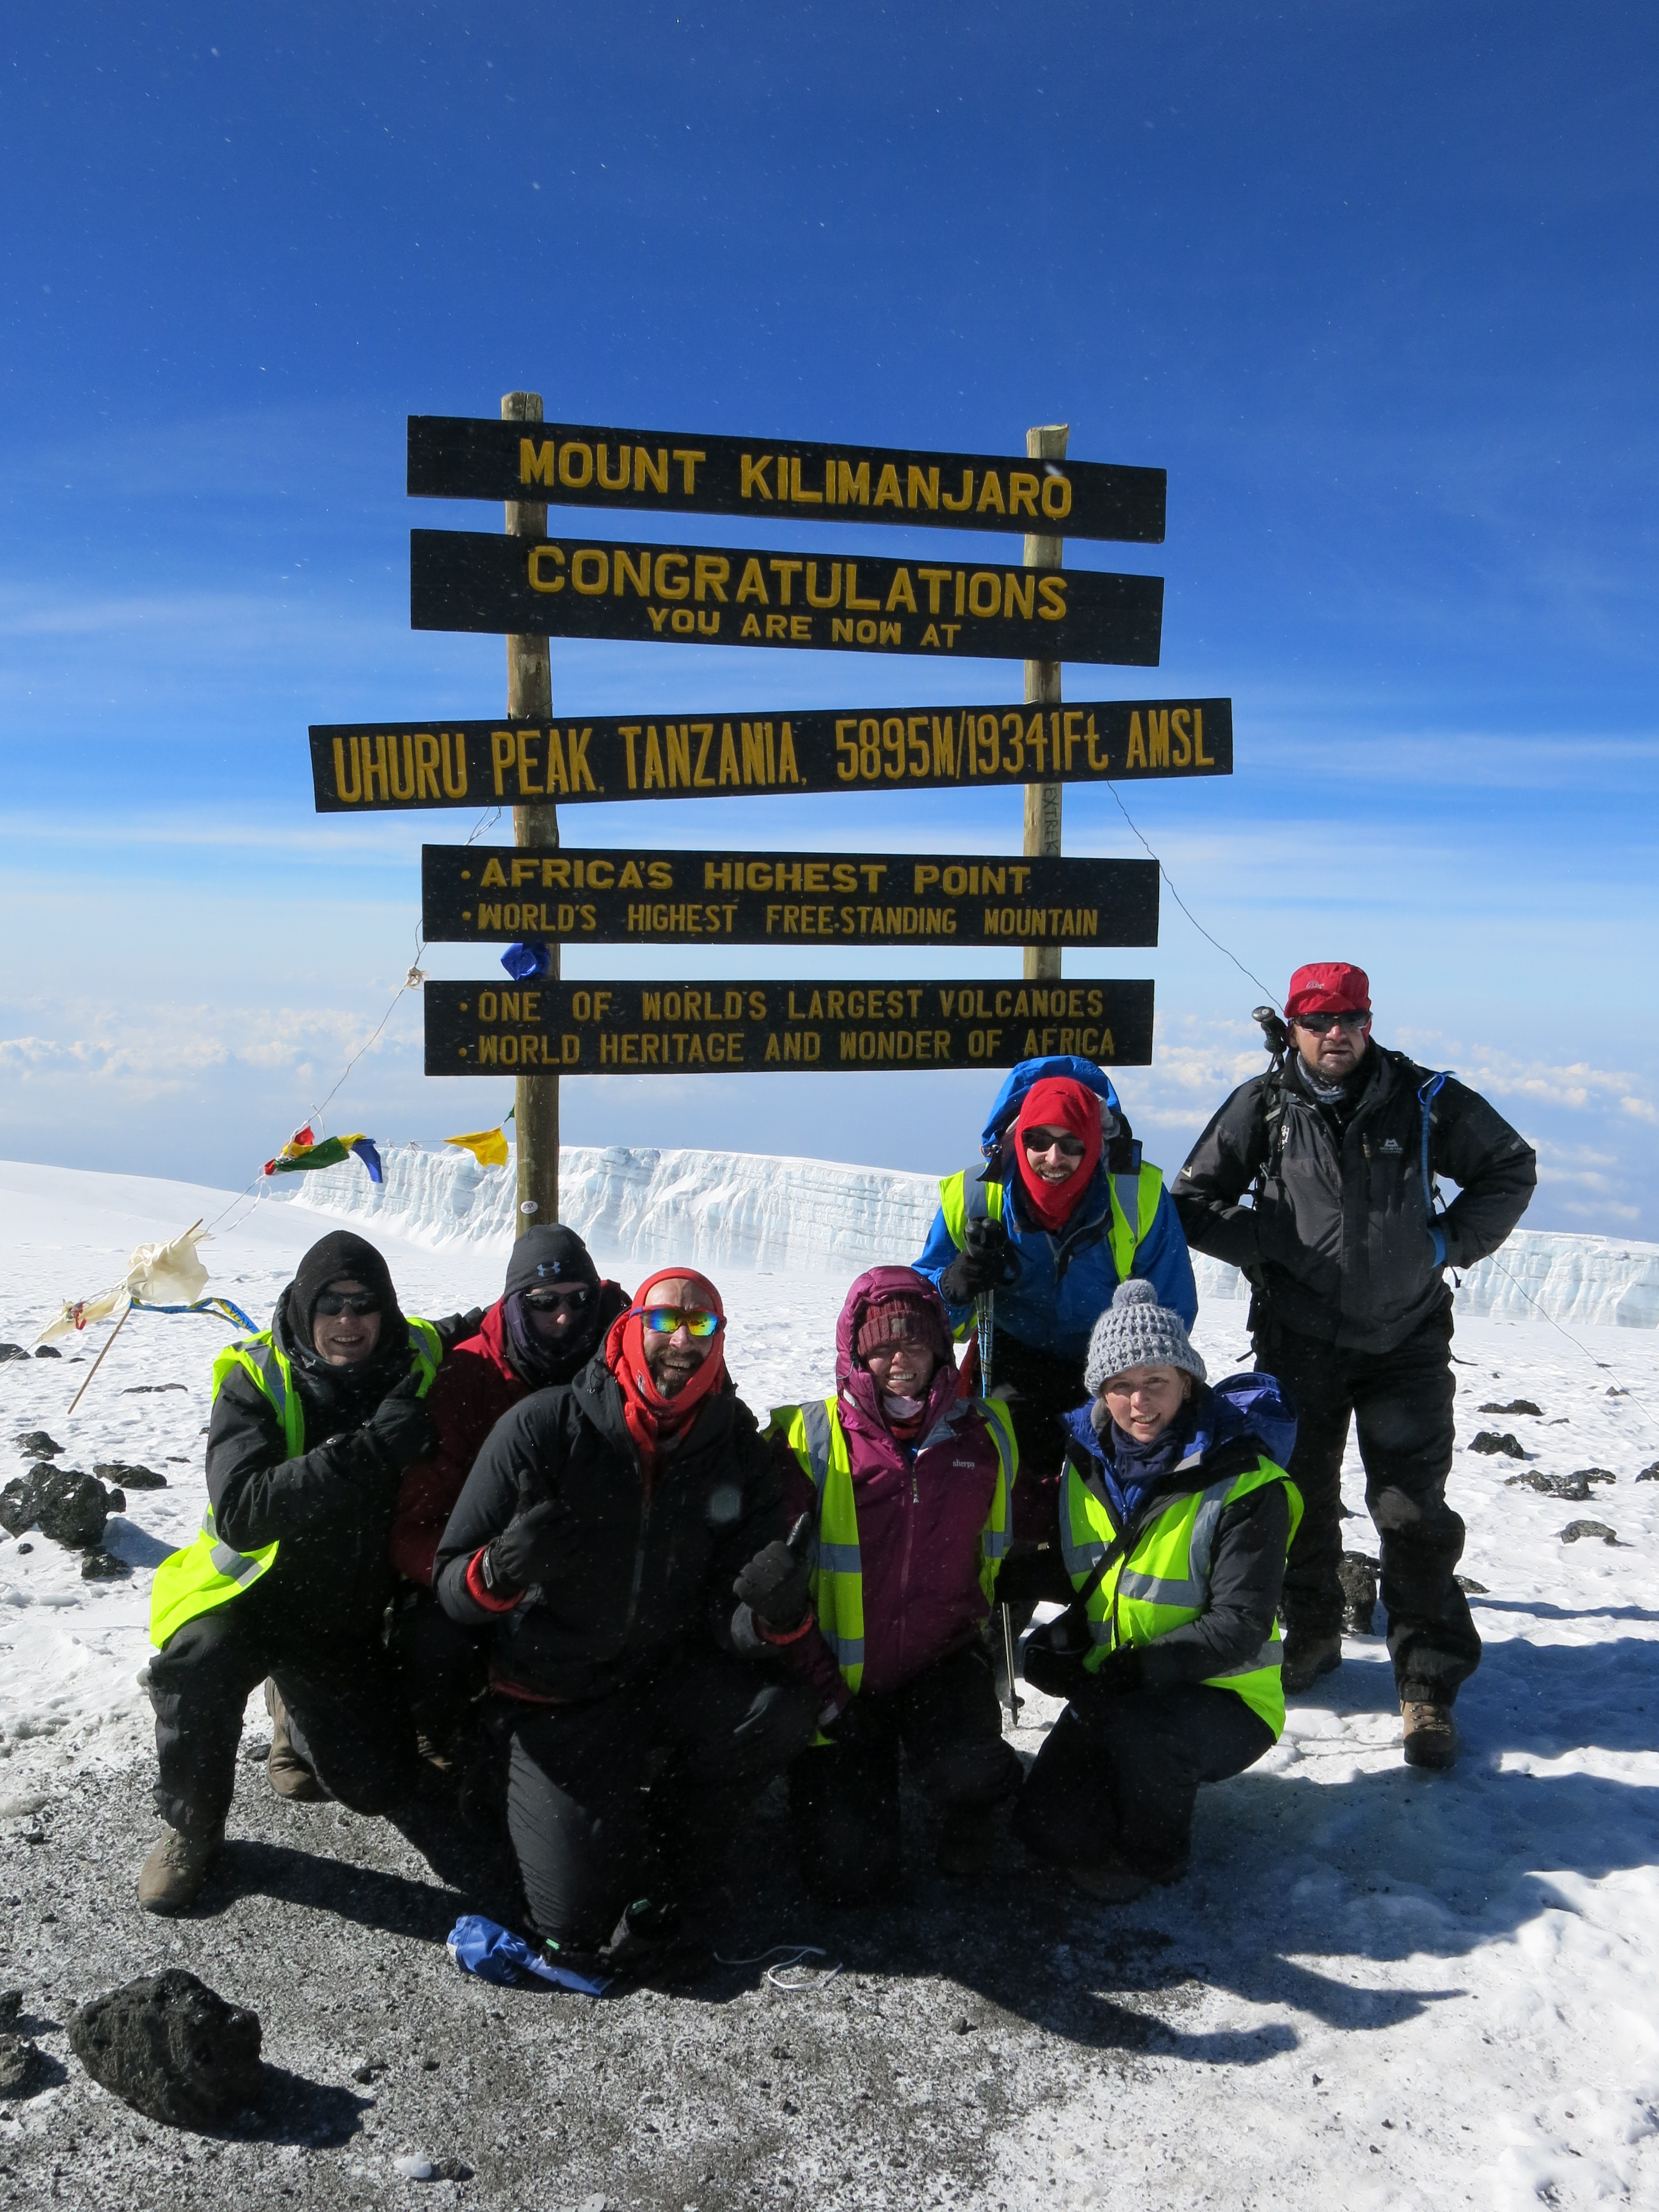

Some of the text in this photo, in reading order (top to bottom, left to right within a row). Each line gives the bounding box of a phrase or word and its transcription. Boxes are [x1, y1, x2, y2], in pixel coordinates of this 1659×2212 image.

[520, 439, 1071, 519] MOUNT KILIMANJARO
[529, 546, 1067, 620] CONGRATULATIONS
[648, 607, 961, 648] YOU ARE NOW AT
[333, 733, 467, 802] UHURU
[1127, 708, 1214, 768] AMSL
[481, 858, 1030, 895] AFRICA'S HIGHEST POINT
[478, 903, 596, 931] WORLD'S
[628, 904, 736, 932] HIGHEST
[985, 909, 1097, 935] MOUNTAIN
[479, 990, 1102, 1021] ONE OF WORLD'S LARGEST VOLCANOES
[479, 1028, 1114, 1064] WORLD HERITAGE AND WONDER OF AFRICA
[953, 1458, 975, 1469] sherpa
